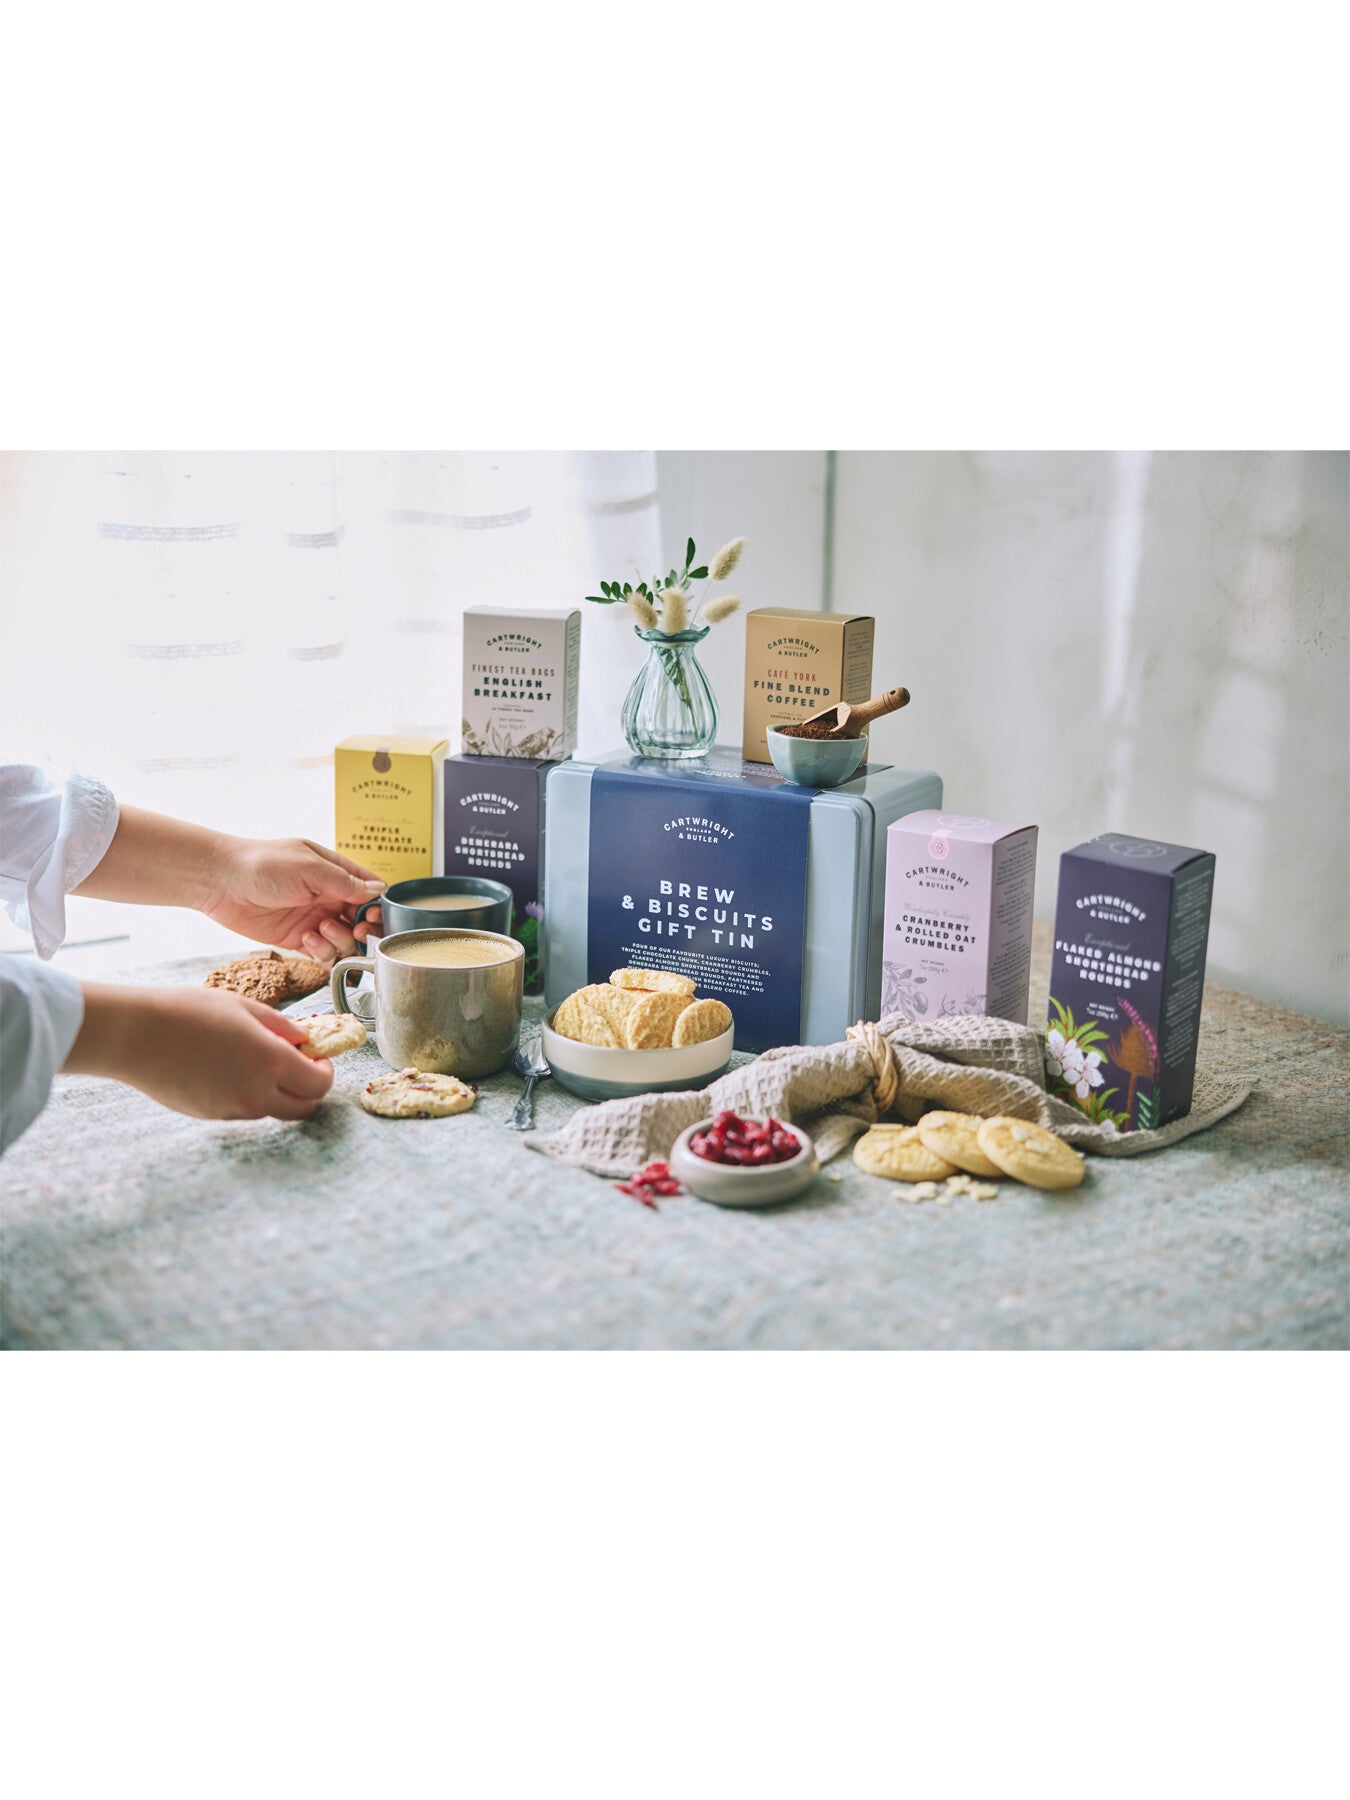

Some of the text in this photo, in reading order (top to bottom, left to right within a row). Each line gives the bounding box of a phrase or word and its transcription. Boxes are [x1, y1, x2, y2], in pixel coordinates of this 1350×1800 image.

[486, 634, 542, 649] CARTWRIGHT
[767, 638, 820, 654] CARTWRIGHT
[472, 664, 555, 676] FINEST TEA BAGS
[767, 669, 816, 682] CAFÉ YORK
[484, 677, 543, 688] ENGLISH
[754, 680, 830, 696] FINE BLEND
[474, 689, 552, 701] BREAKFAST
[767, 695, 815, 707] COFFEE
[460, 793, 519, 812] CARTWRIGHT
[364, 826, 400, 834] TRIPLE
[664, 817, 735, 840] CARTWRIGHT
[352, 834, 412, 844] CHOCOLATE
[461, 837, 519, 850] DEMERARA
[687, 834, 718, 844] BUTLER
[338, 842, 427, 854] CHUNK BISCUITS
[455, 846, 525, 861] SHORTBREAD
[468, 857, 511, 869] ROUNDS
[906, 866, 970, 888] CARTWRIGHT
[660, 880, 735, 904] BREW
[926, 882, 954, 891] BUTLER
[622, 895, 773, 931] & BISCUITS
[1076, 894, 1147, 922] CARTWRIGHT
[903, 915, 970, 932] CRANBERRY
[1090, 909, 1130, 925] & BUTLER
[638, 918, 754, 949] GIFT TIN
[907, 926, 949, 939] ROLLED
[955, 934, 976, 944] OAT
[905, 937, 965, 952] CRUMBLES
[643, 950, 676, 960] CHOCOLATE
[702, 960, 736, 970] CRANBERRY
[673, 950, 704, 959] FAVOURITE
[1056, 940, 1161, 972] FLAKED ALMOND
[629, 960, 659, 969] DEMERARA
[661, 966, 698, 975] SHORTBREAD
[728, 977, 763, 986] PARTNERED
[681, 963, 719, 972] SHORTBREAD
[1065, 954, 1149, 981] SHORTBREAD
[704, 979, 737, 988] BREAKFAST
[1080, 969, 1131, 989] ROUNDS
